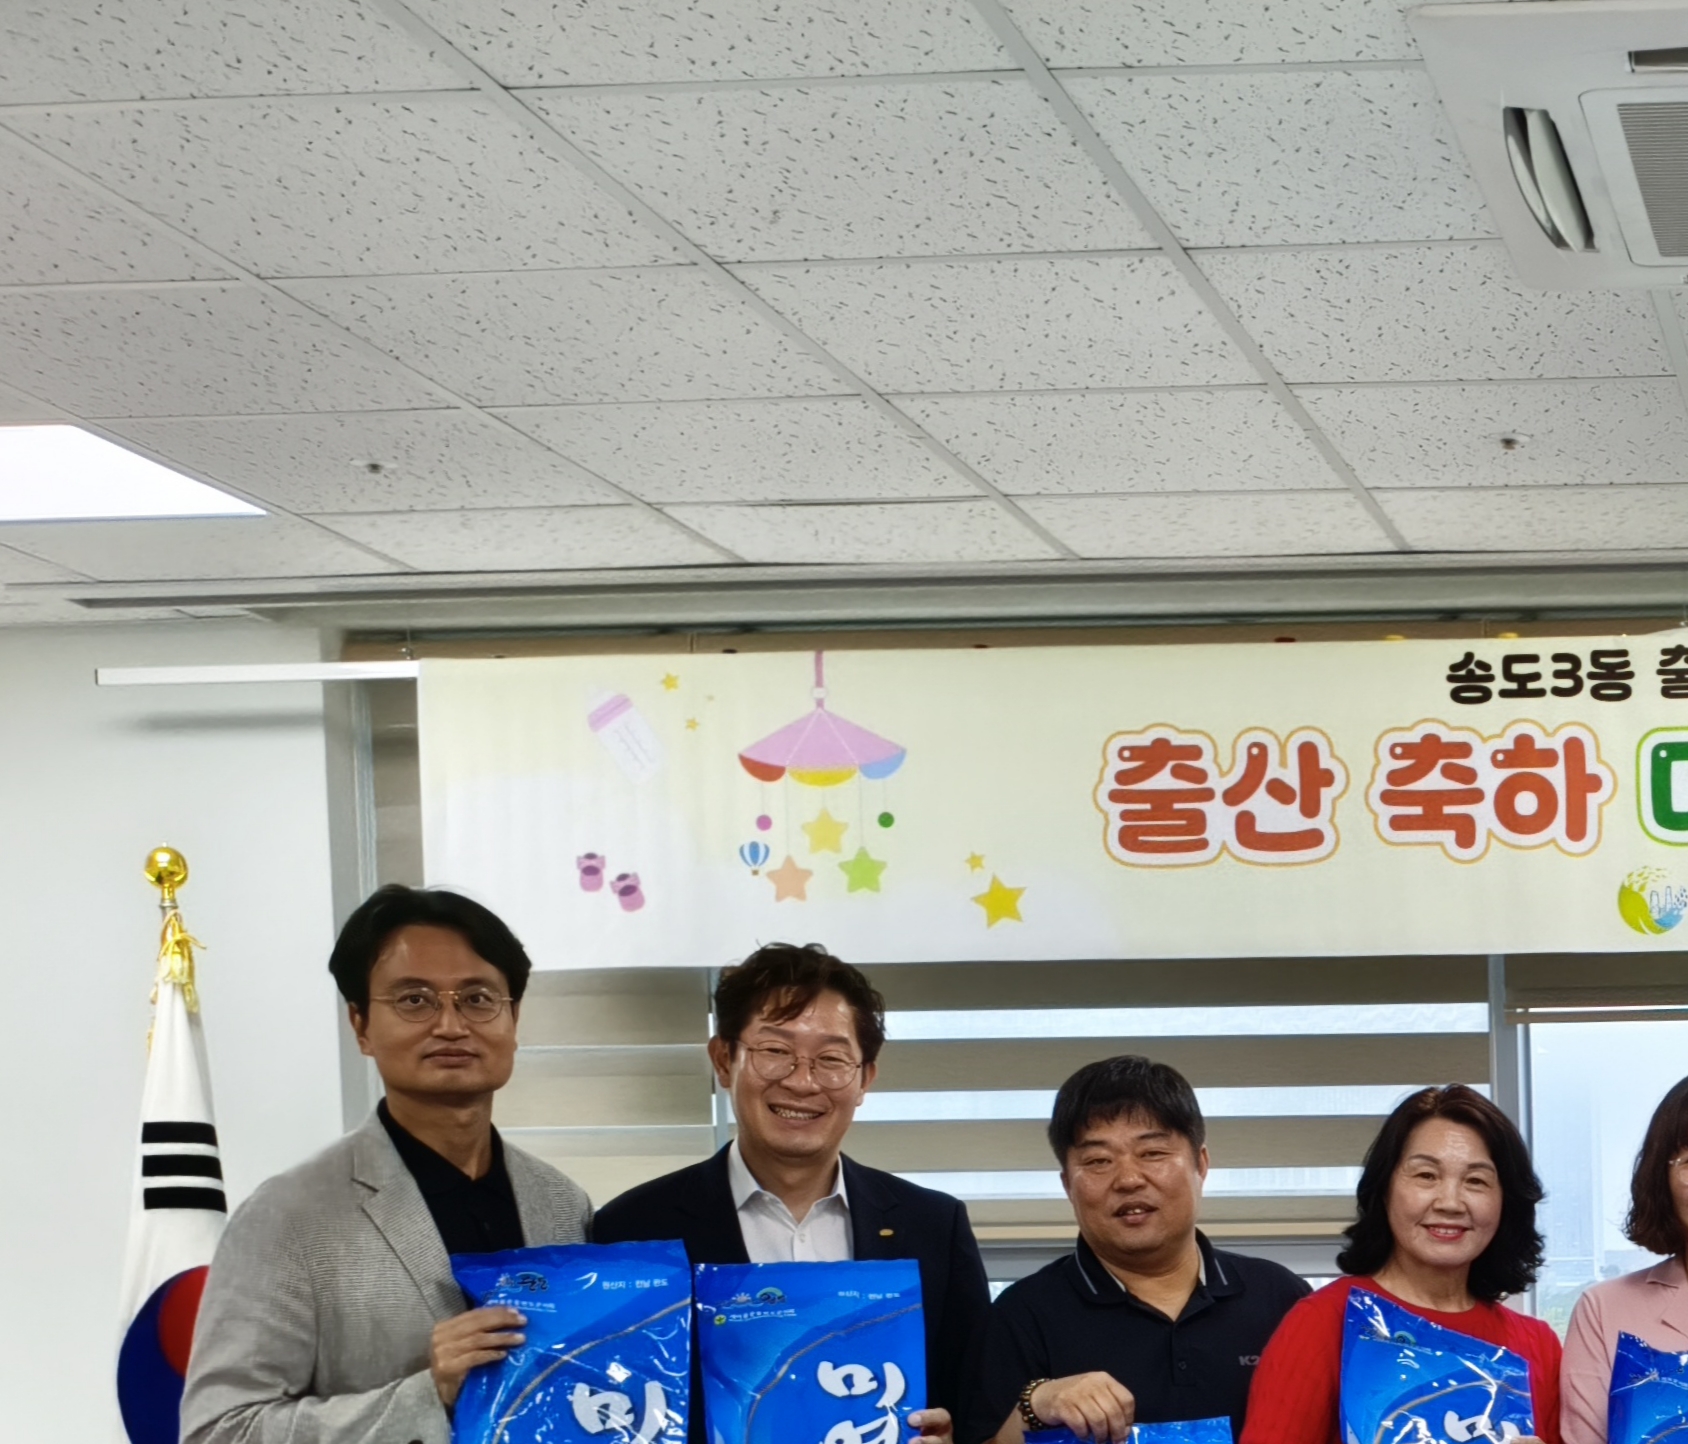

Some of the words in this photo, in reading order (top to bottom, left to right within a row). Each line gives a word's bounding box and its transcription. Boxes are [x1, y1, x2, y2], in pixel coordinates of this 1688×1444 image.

[1446, 649, 1635, 704] 송도3동
[1109, 738, 1334, 853] 출산
[1377, 732, 1600, 846] 축하
